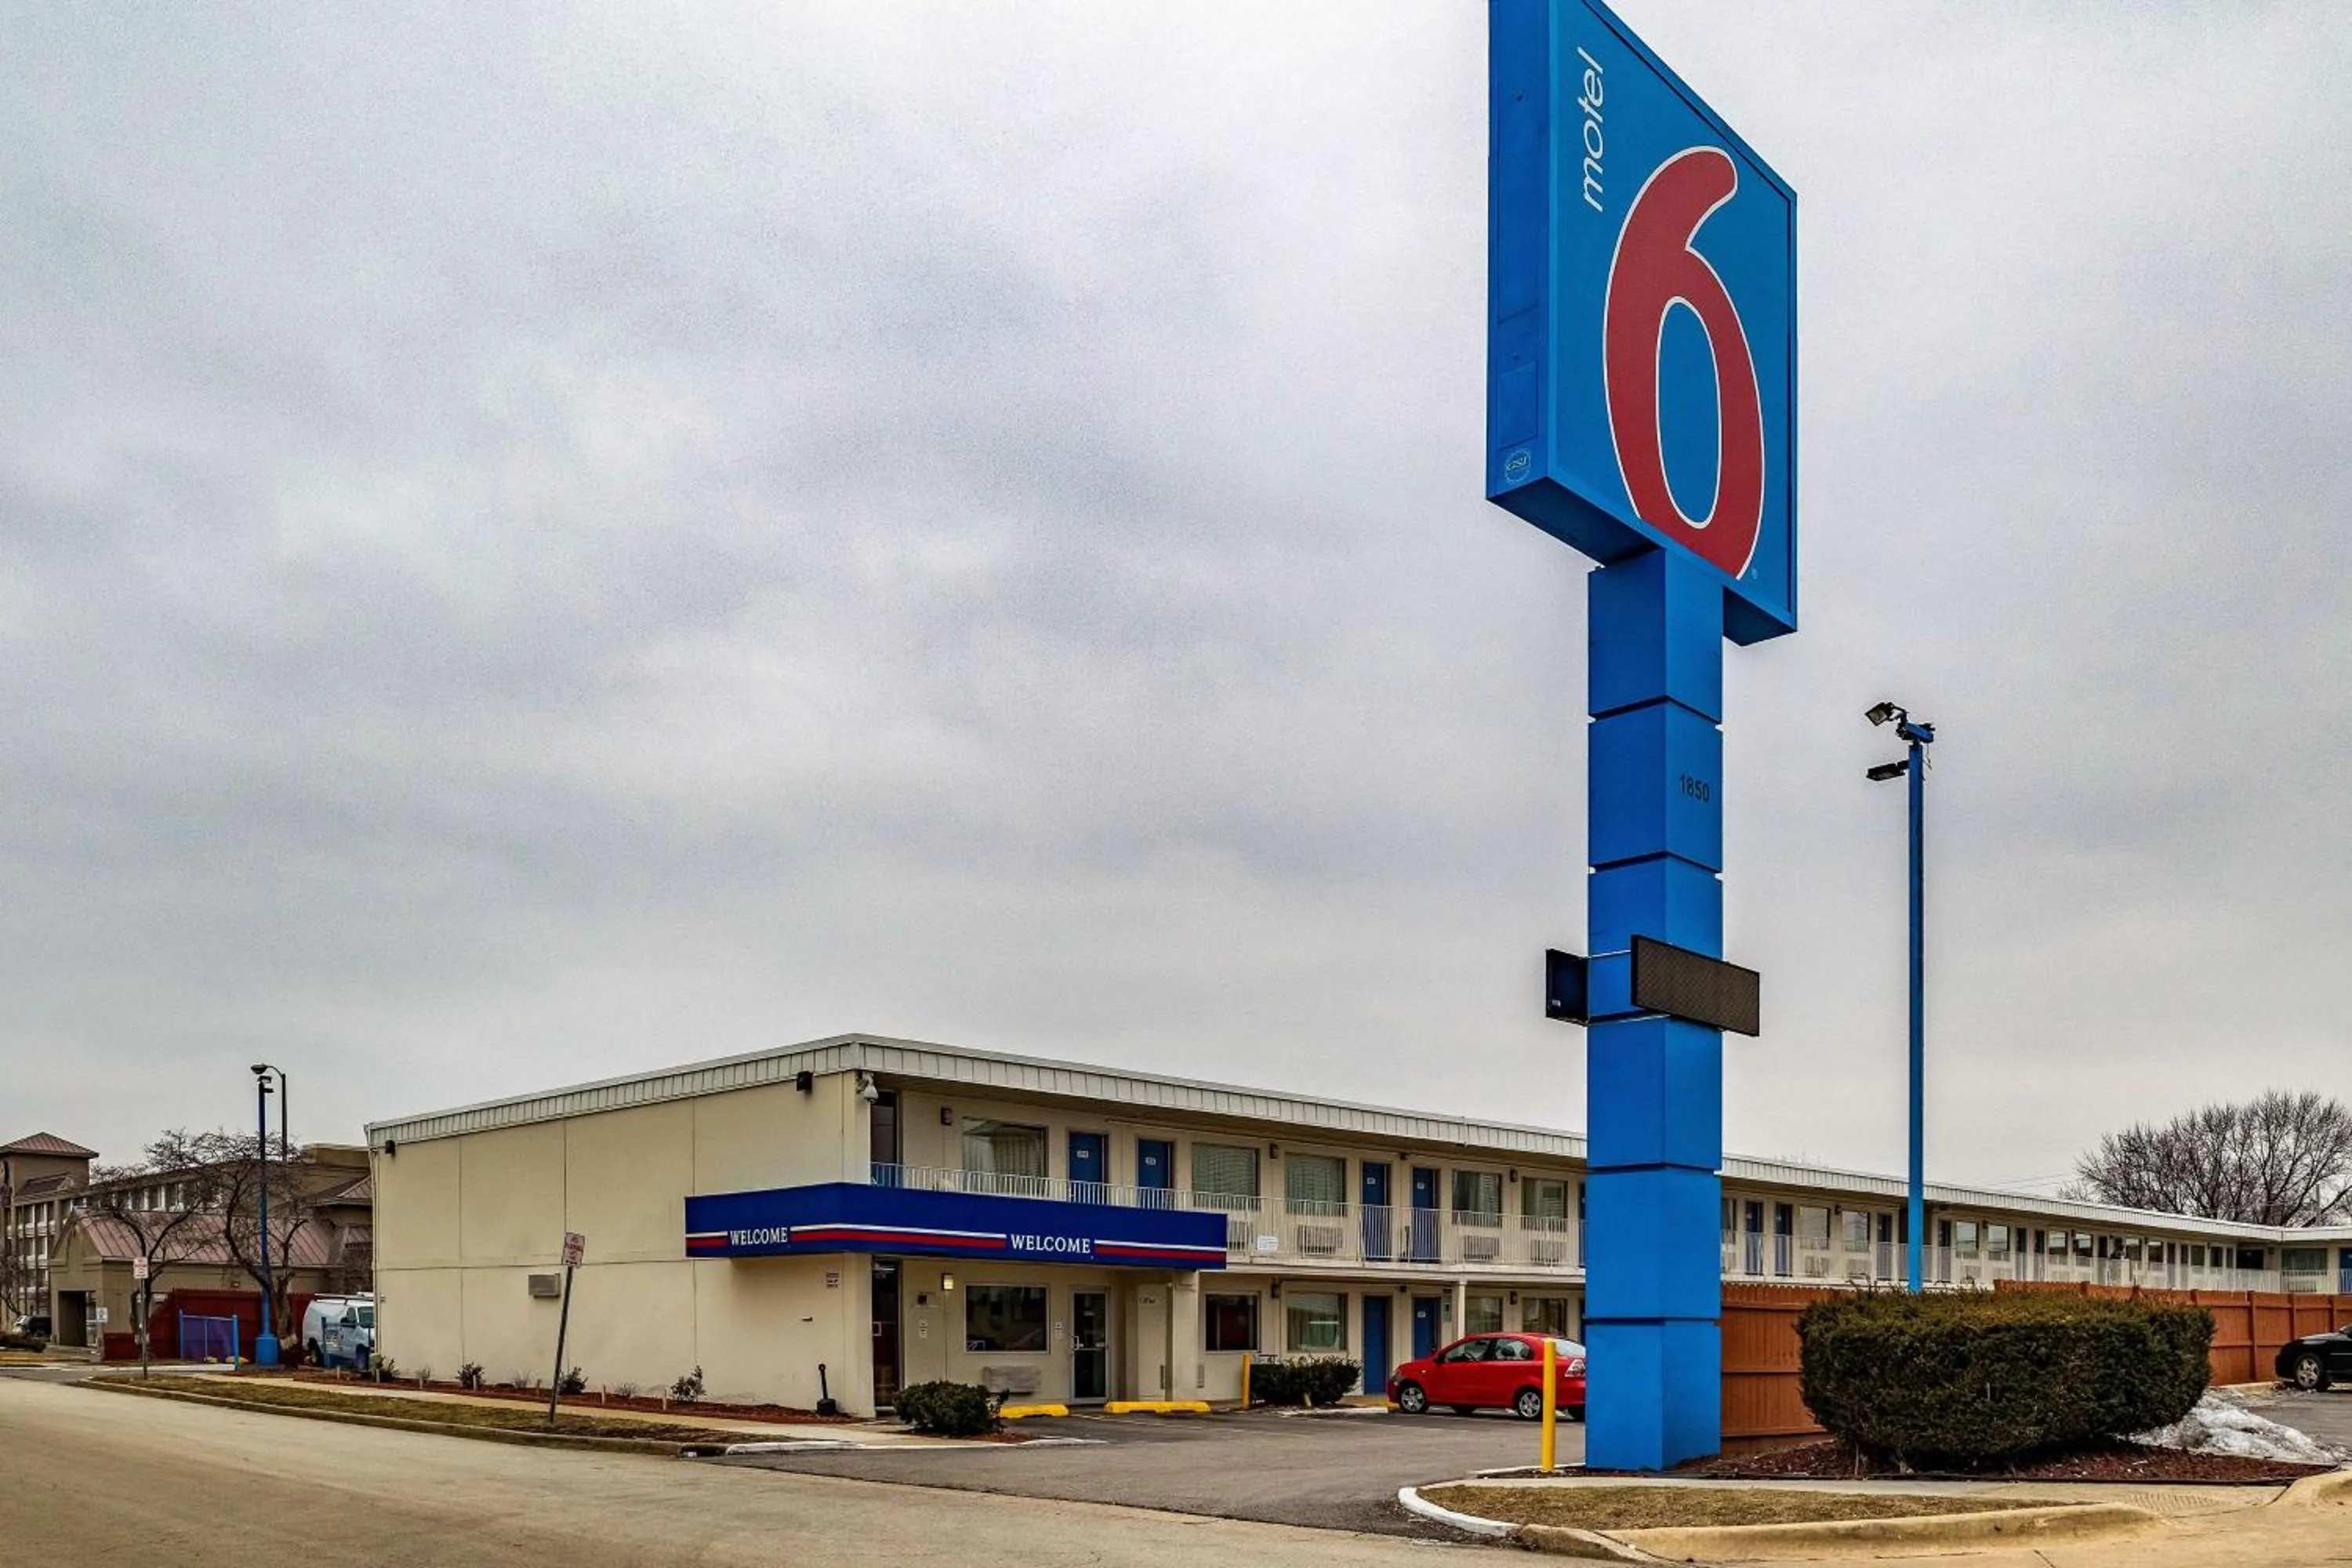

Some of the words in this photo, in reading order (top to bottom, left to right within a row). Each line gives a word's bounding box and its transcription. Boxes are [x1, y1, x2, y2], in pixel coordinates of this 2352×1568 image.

[1577, 45, 1604, 213] motel
[1602, 145, 1766, 580] 6
[1679, 773, 1710, 804] 1850
[730, 1227, 788, 1246] WELCOME
[1011, 1233, 1091, 1254] WELCOME
